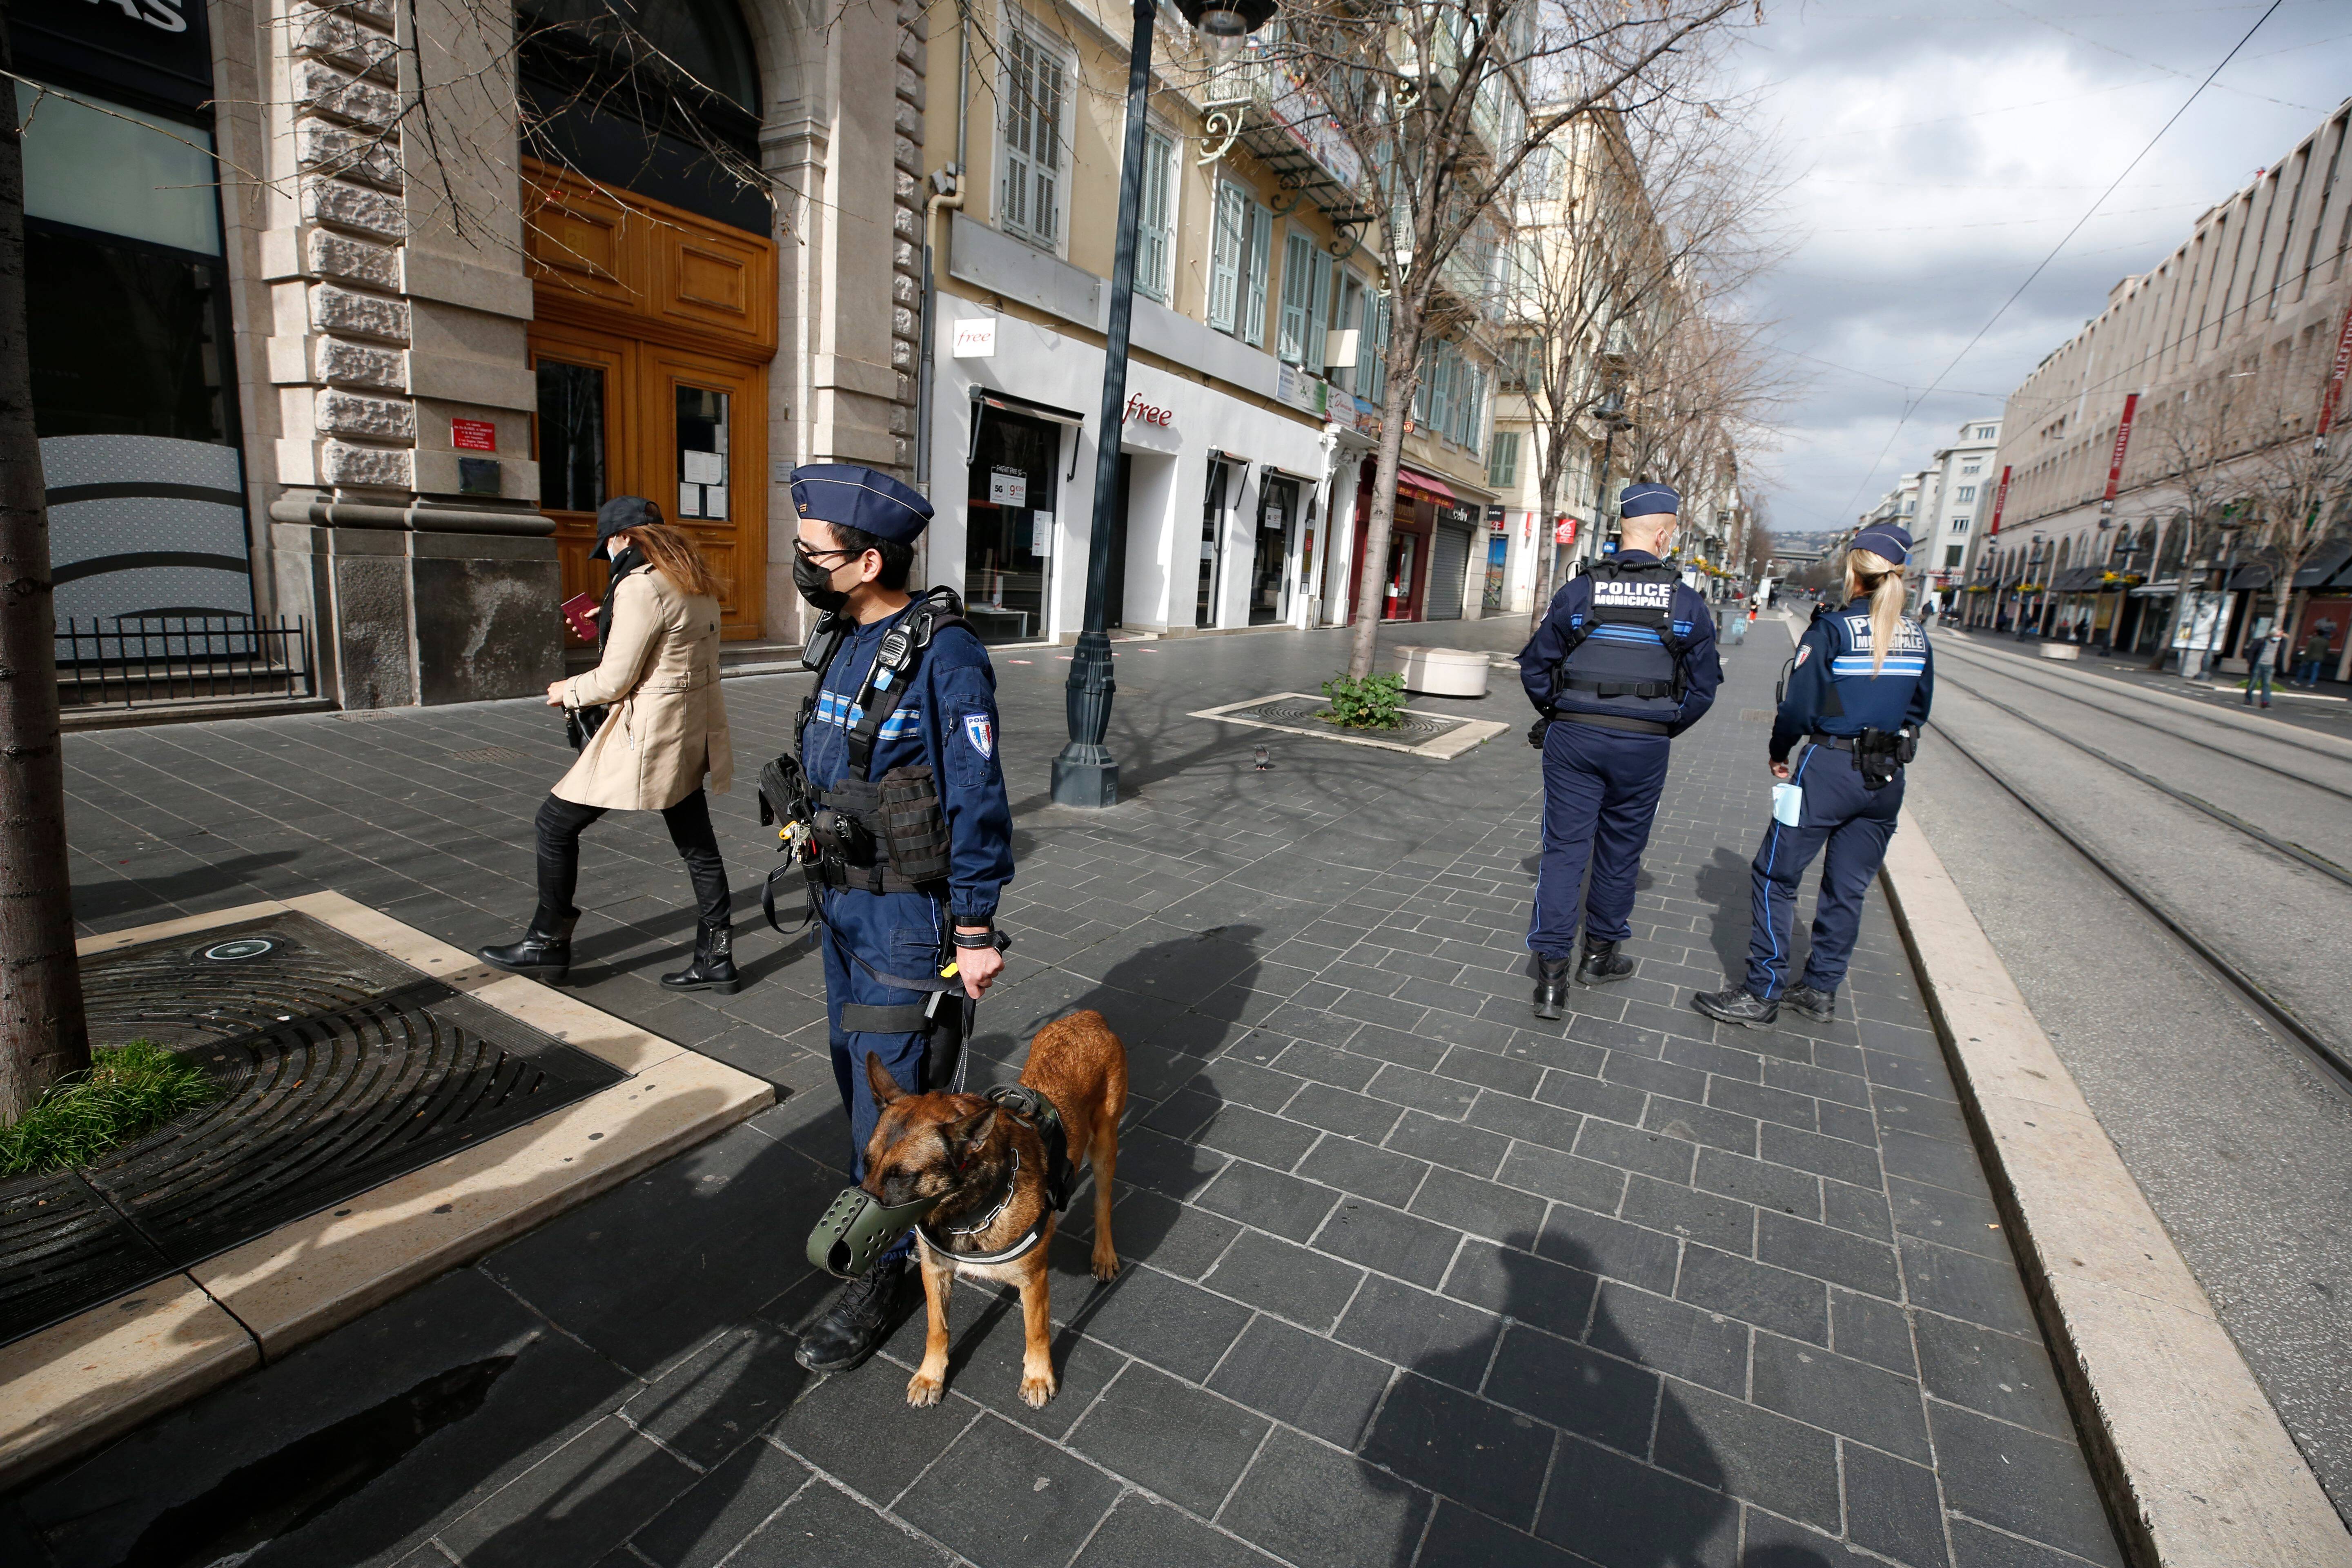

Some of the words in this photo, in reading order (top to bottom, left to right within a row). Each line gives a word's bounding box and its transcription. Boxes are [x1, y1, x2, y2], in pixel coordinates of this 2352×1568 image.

[957, 330, 990, 346] free
[1122, 392, 1172, 426] free
[1453, 508, 1468, 522] celio
[1595, 581, 1670, 597] POLICE
[1595, 595, 1669, 608] MUNICIPALE
